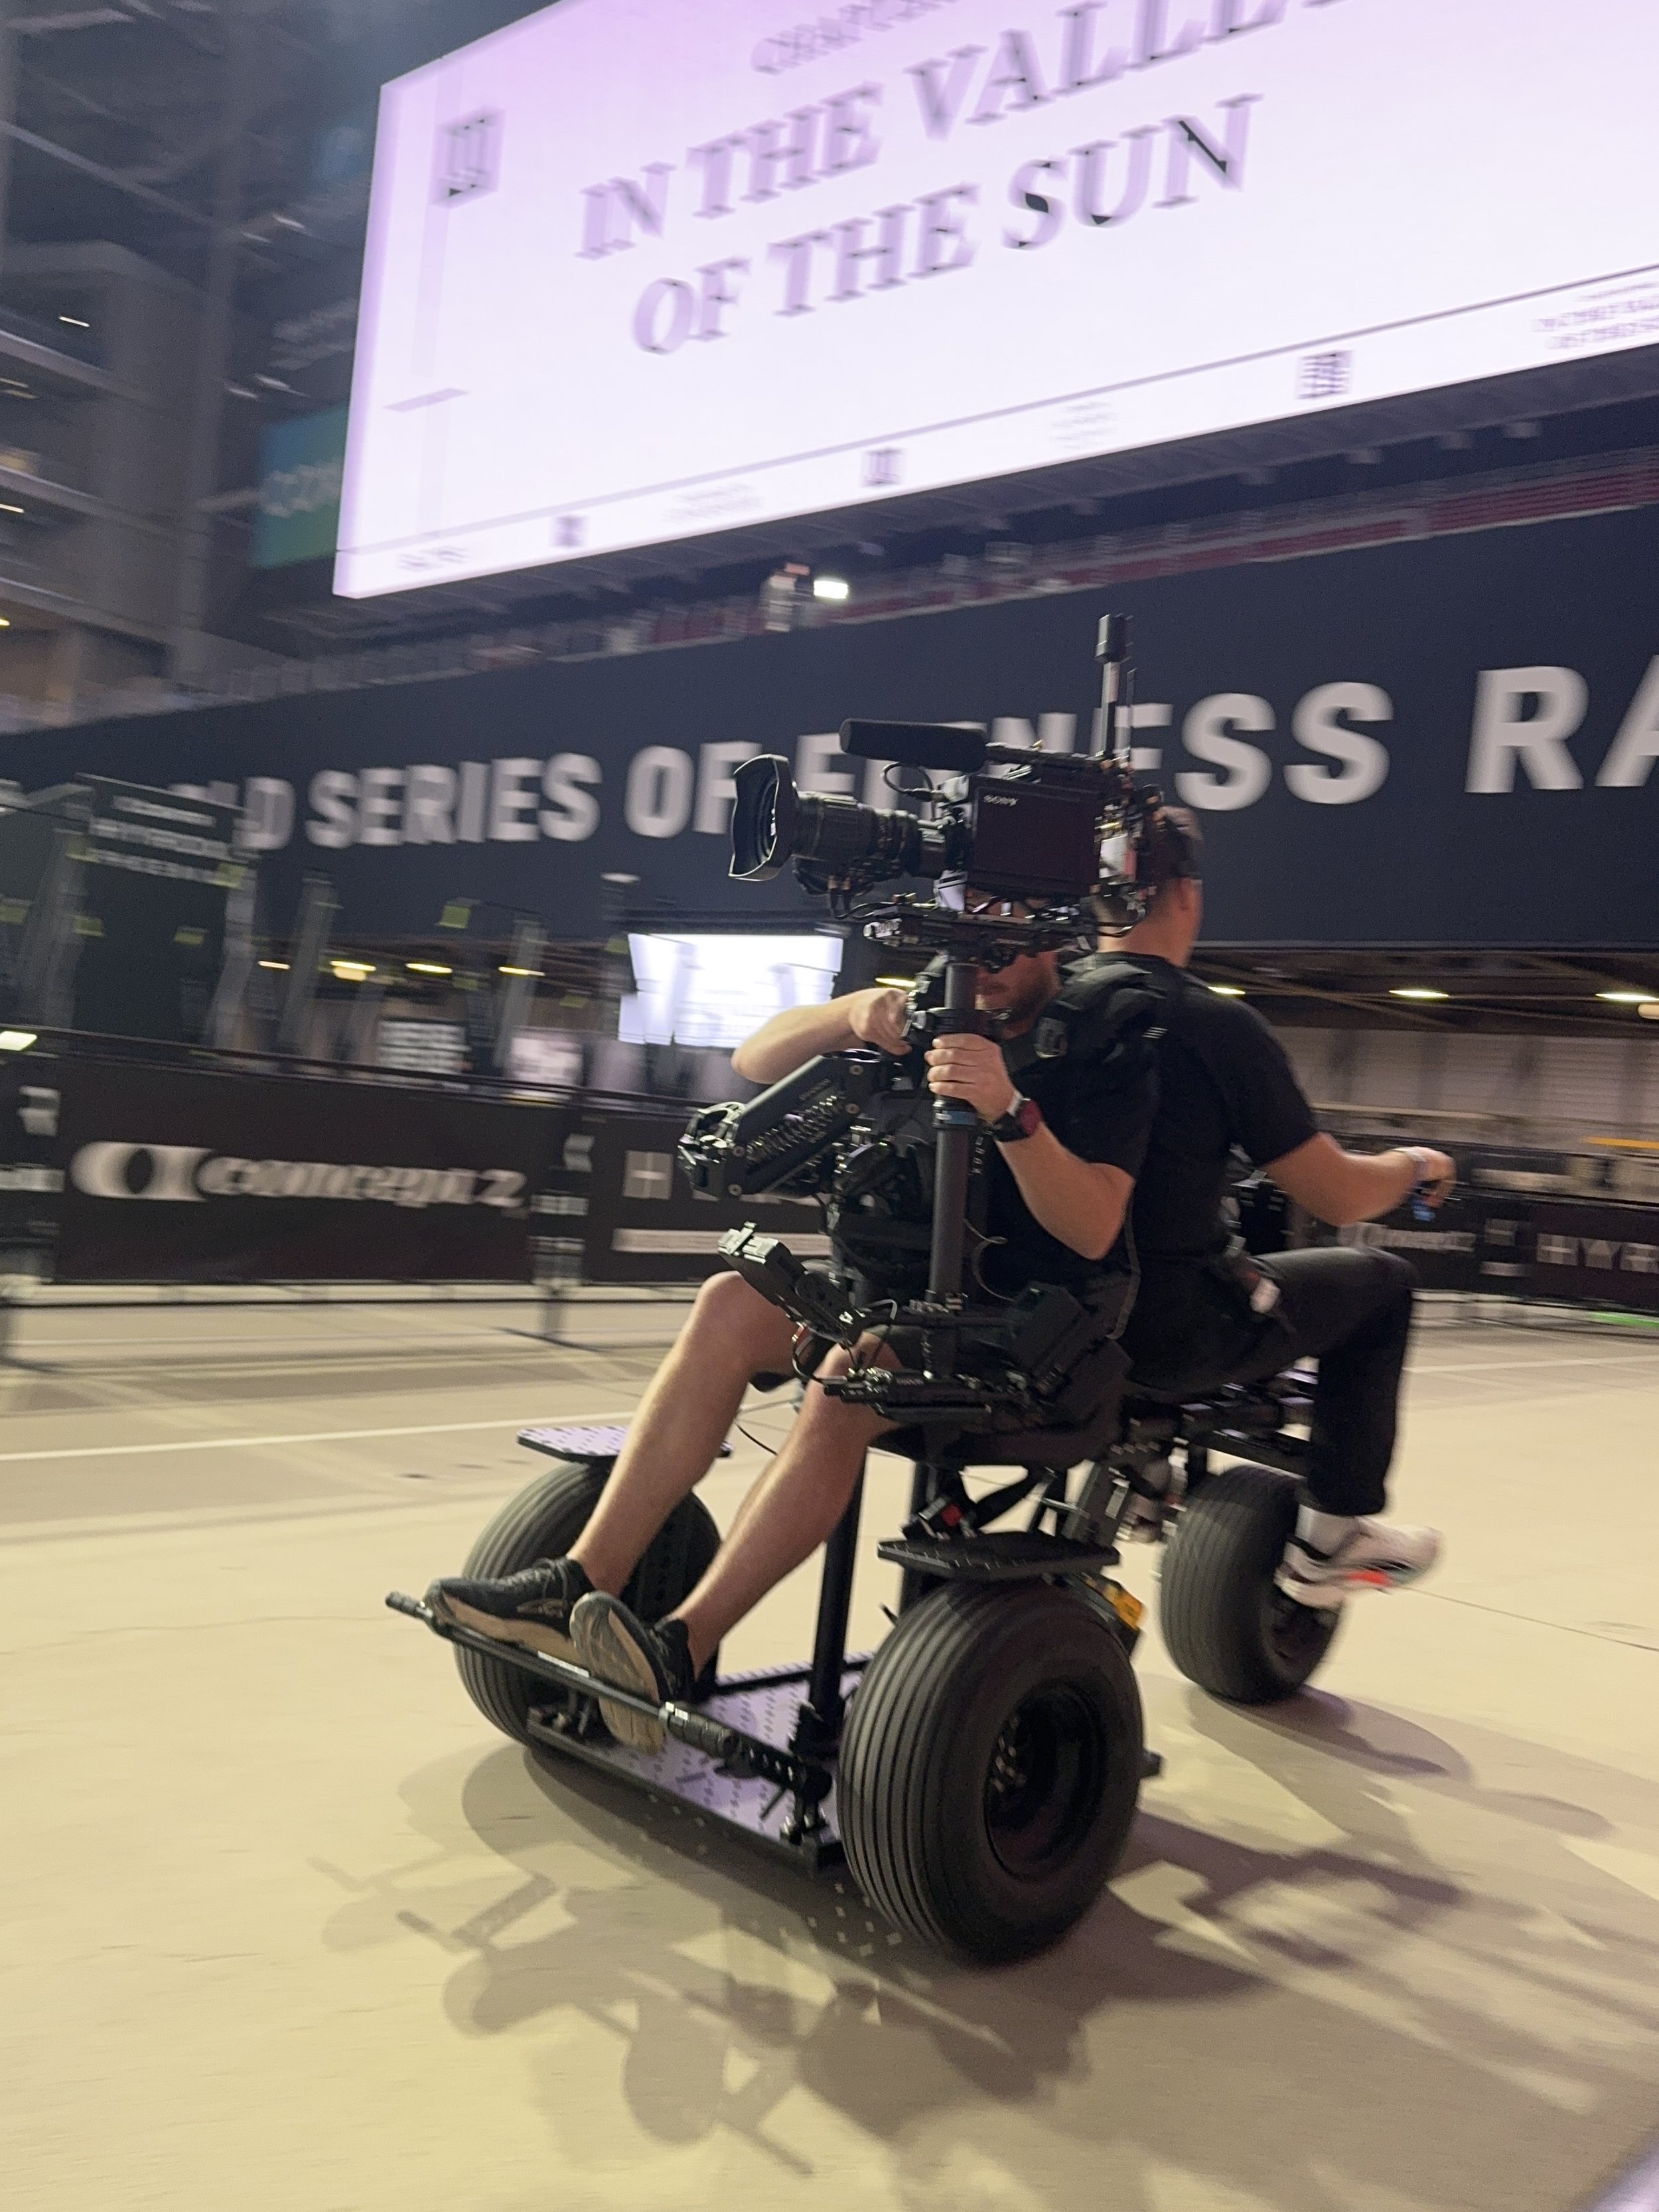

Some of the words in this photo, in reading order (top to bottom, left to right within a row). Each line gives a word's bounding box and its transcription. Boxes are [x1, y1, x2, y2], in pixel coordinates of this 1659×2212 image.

[575, 161, 676, 261] IN
[685, 82, 884, 220] THE
[631, 256, 751, 355] OF
[766, 182, 980, 317] THE
[1001, 92, 1265, 251] SUN
[305, 752, 604, 849] SERIES
[624, 739, 762, 840] OF
